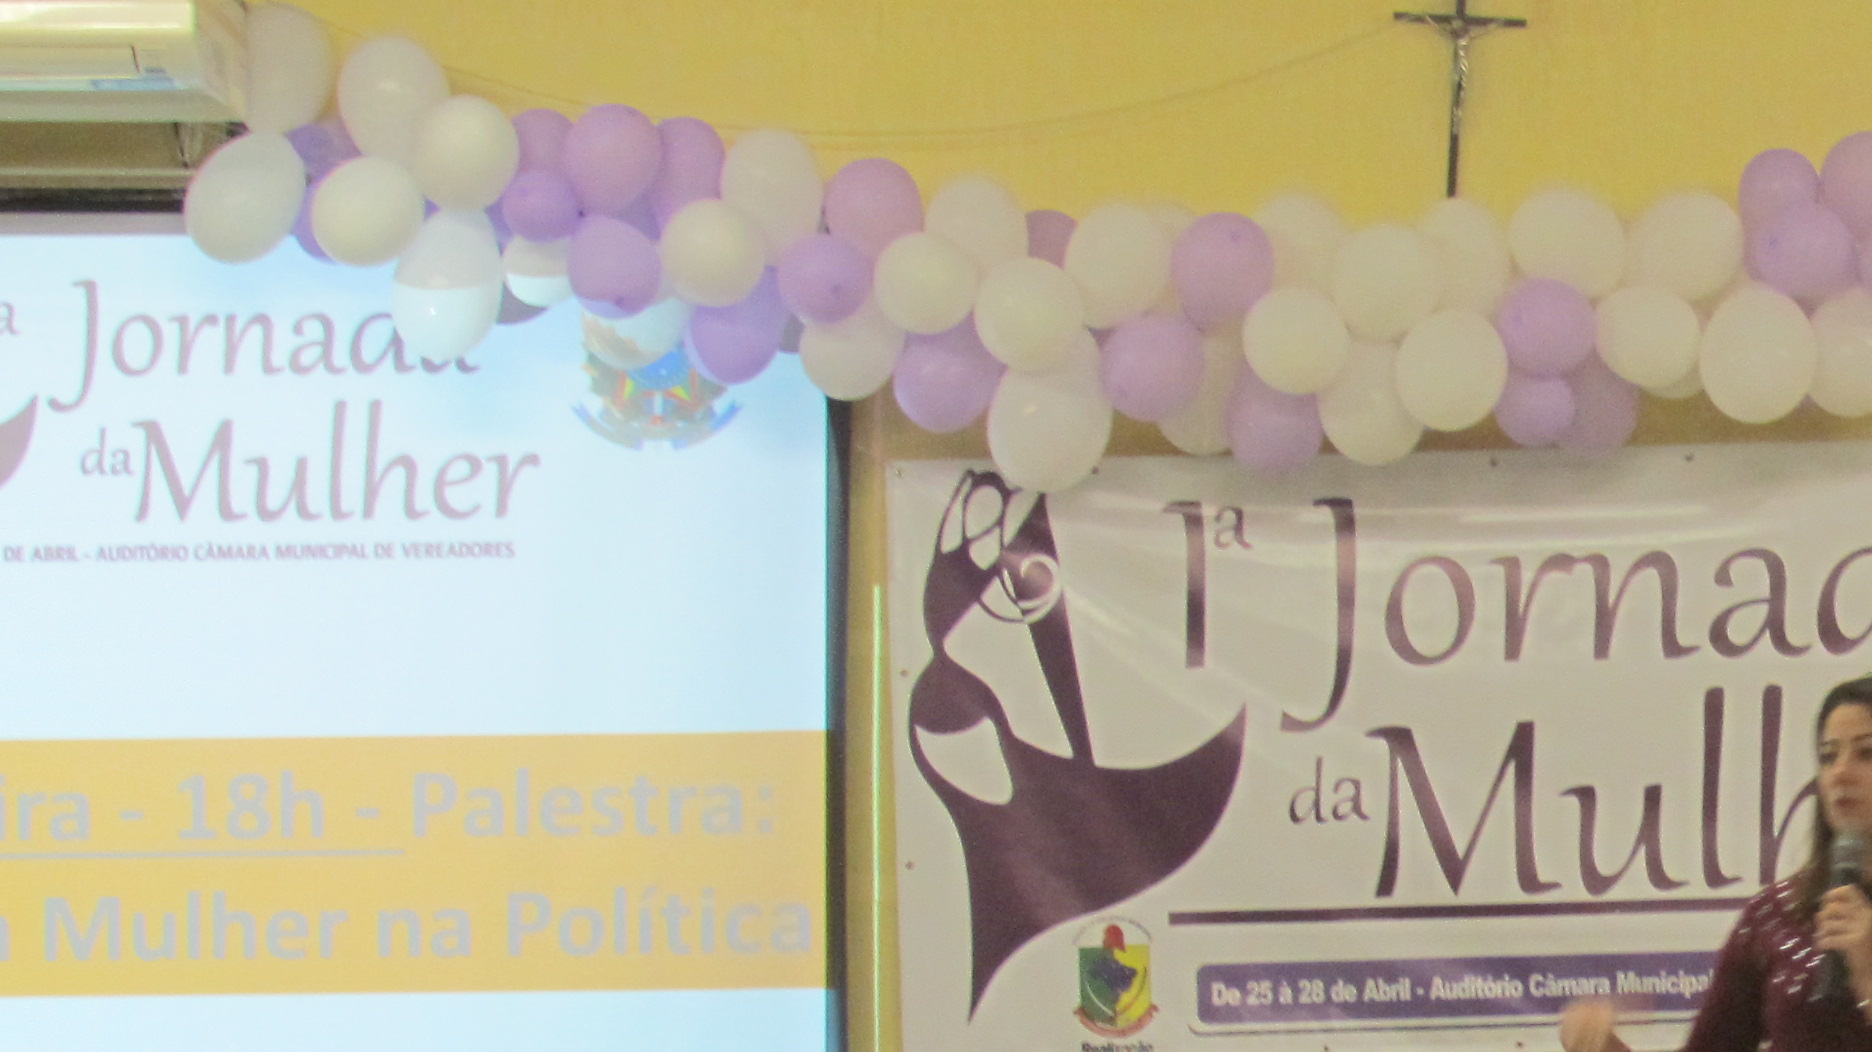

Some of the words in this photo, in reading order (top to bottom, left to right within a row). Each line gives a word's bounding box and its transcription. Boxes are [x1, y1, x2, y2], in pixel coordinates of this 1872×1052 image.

[47, 279, 481, 413] Jornad
[80, 426, 134, 477] da
[131, 399, 542, 522] Mulher
[4, 545, 25, 563] DE
[275, 543, 369, 561] MUNICIPAL
[373, 542, 396, 559] DE
[402, 541, 516, 560] VEREADORES
[178, 769, 325, 840] 18h
[412, 767, 774, 839] Palestra:
[1288, 756, 1371, 824] da
[44, 890, 350, 962] Mulher
[376, 906, 473, 959] na
[507, 885, 813, 958] Política
[1210, 981, 1242, 1006] De
[1246, 979, 1275, 1005] 25
[1298, 978, 1326, 1004] 28
[1330, 977, 1358, 1003] de
[1362, 975, 1412, 1003] Abril
[1430, 971, 1524, 1001] Auditório
[1529, 970, 1612, 998] Câmara
